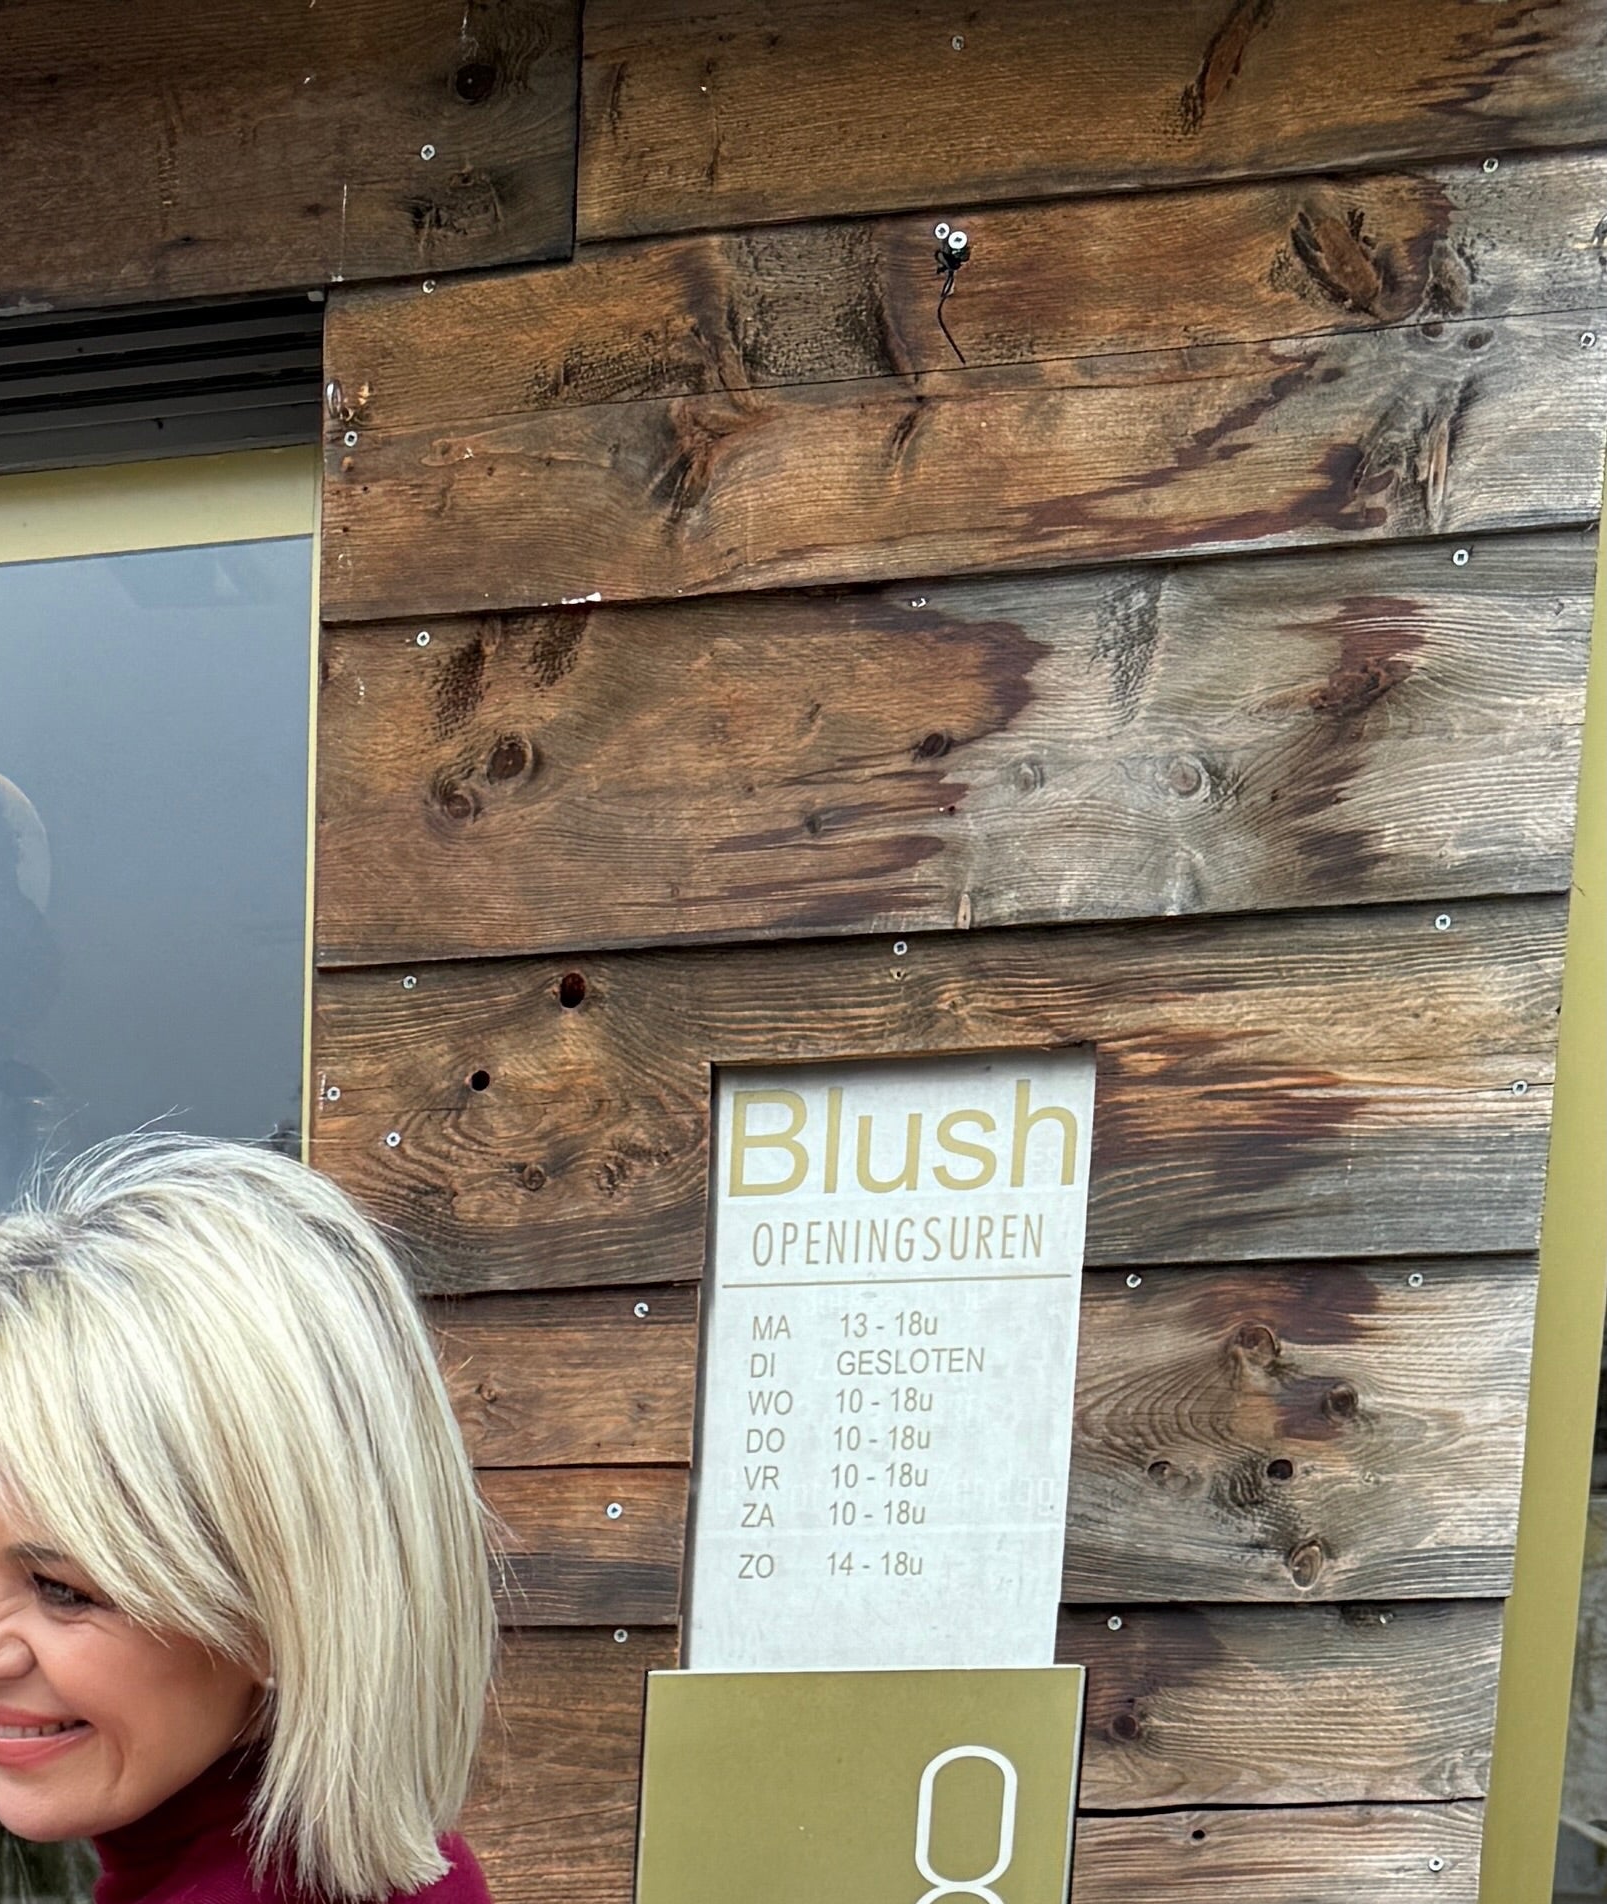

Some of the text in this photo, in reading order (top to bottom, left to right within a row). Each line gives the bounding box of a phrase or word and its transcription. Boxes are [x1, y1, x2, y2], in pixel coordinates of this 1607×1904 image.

[728, 1079, 1078, 1197] Blush
[752, 1213, 1044, 1268] OPENINGSUREN
[752, 1314, 792, 1341] MA
[840, 1312, 868, 1339] 13
[895, 1310, 938, 1337] 18u
[750, 1347, 985, 1379] DI GESLOTEN
[747, 1389, 794, 1416] WO
[836, 1387, 863, 1414] 10
[890, 1386, 933, 1413] 18u
[746, 1427, 786, 1454] DO
[833, 1425, 861, 1452] 10
[888, 1425, 931, 1451] 18u
[743, 1465, 780, 1491] VR
[831, 1463, 859, 1489] 10
[885, 1462, 928, 1488] 18u
[740, 1502, 775, 1528] ZA
[829, 1500, 856, 1526] 10
[883, 1499, 926, 1525] 18u
[737, 1553, 775, 1580] ZO
[827, 1551, 854, 1576] 14
[881, 1551, 923, 1576] 18u
